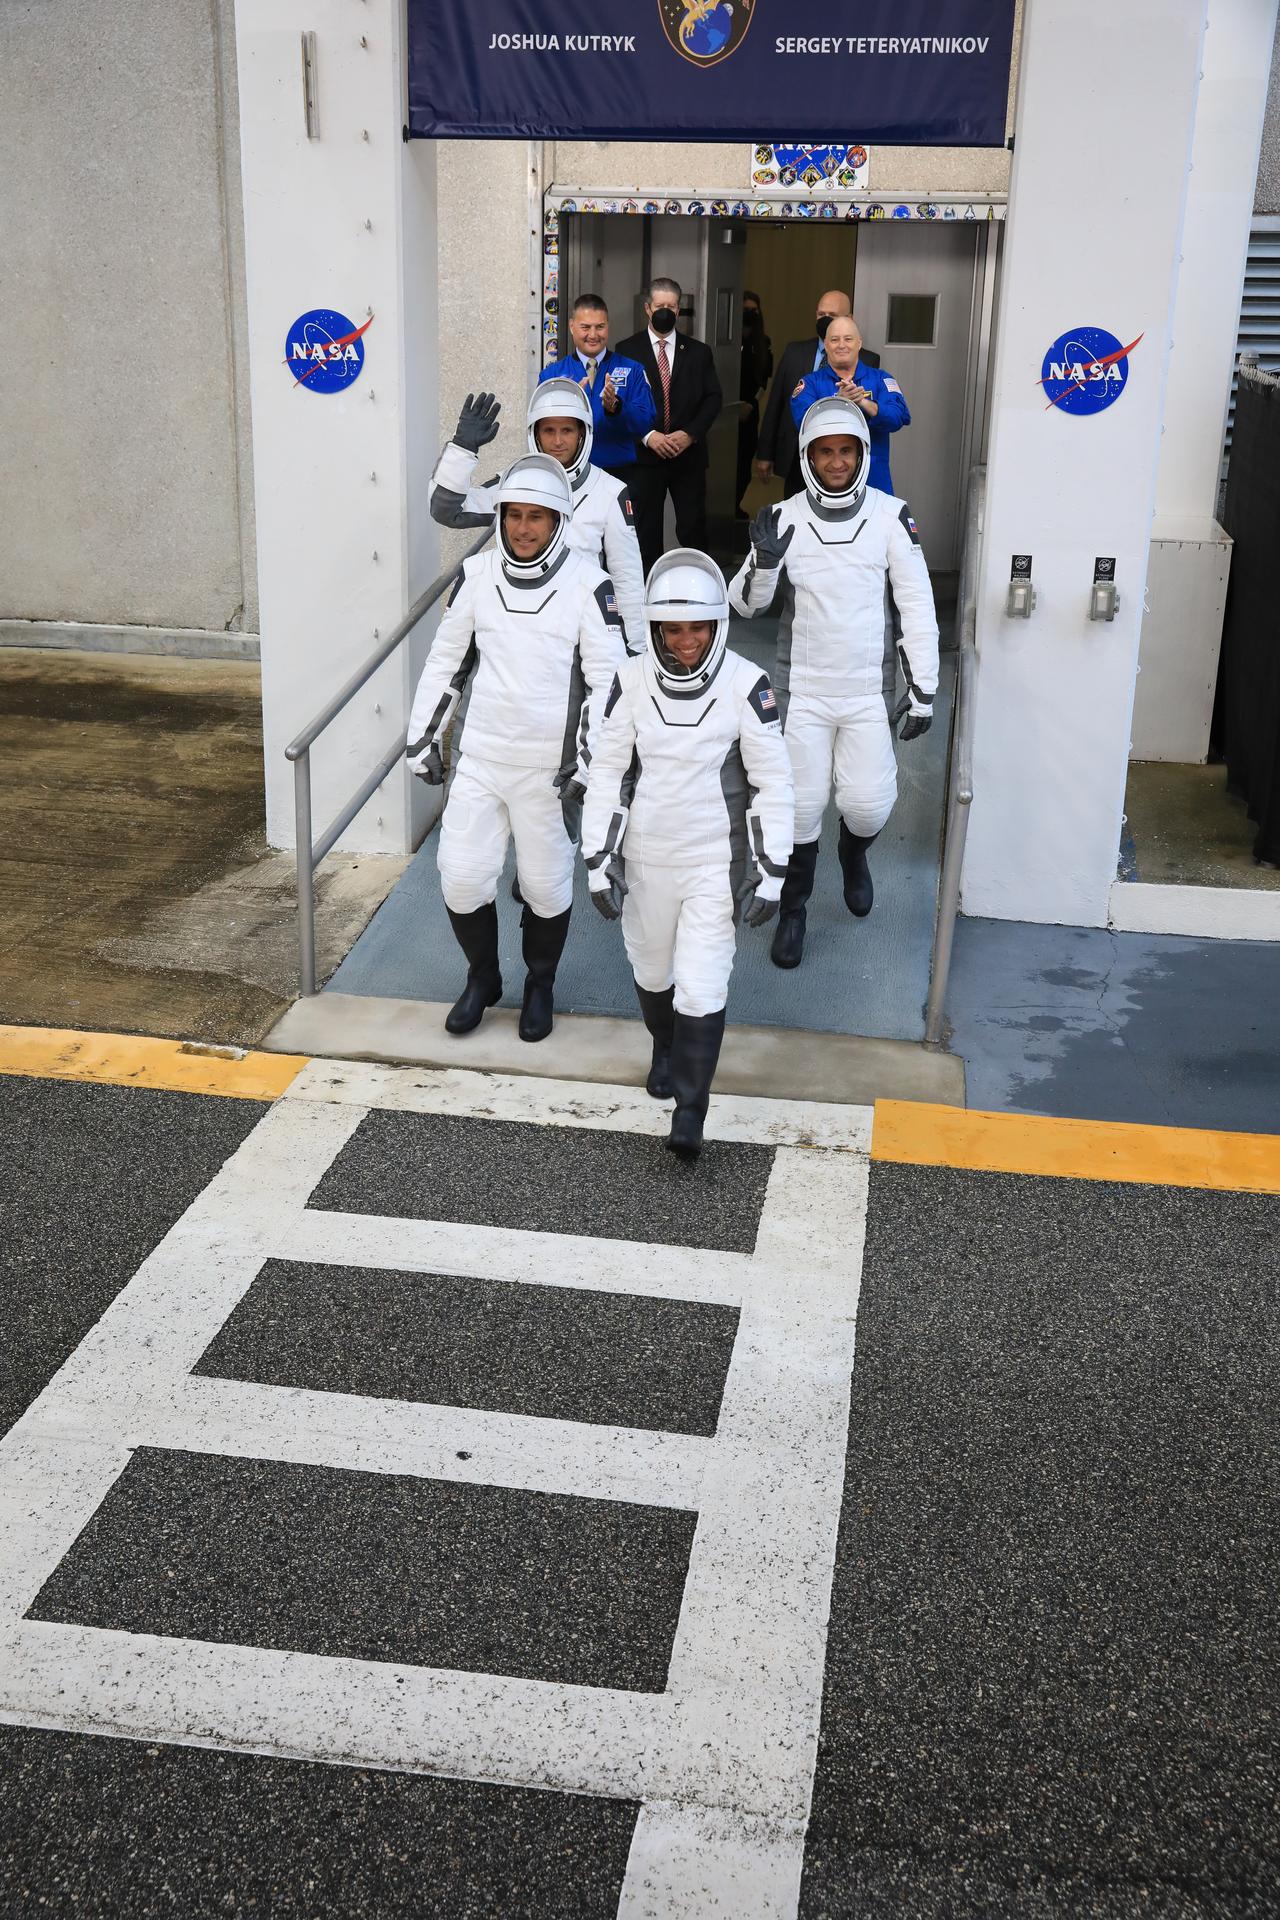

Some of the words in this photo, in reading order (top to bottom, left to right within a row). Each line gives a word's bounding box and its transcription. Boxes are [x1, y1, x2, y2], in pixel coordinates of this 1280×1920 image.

[488, 33, 560, 50] JOSHUA
[565, 35, 636, 52] KUTRYK
[775, 36, 843, 54] SERGEY
[846, 37, 990, 54] TETERYATNIKOV
[292, 342, 360, 361] NASA
[1048, 362, 1123, 381] NASA
